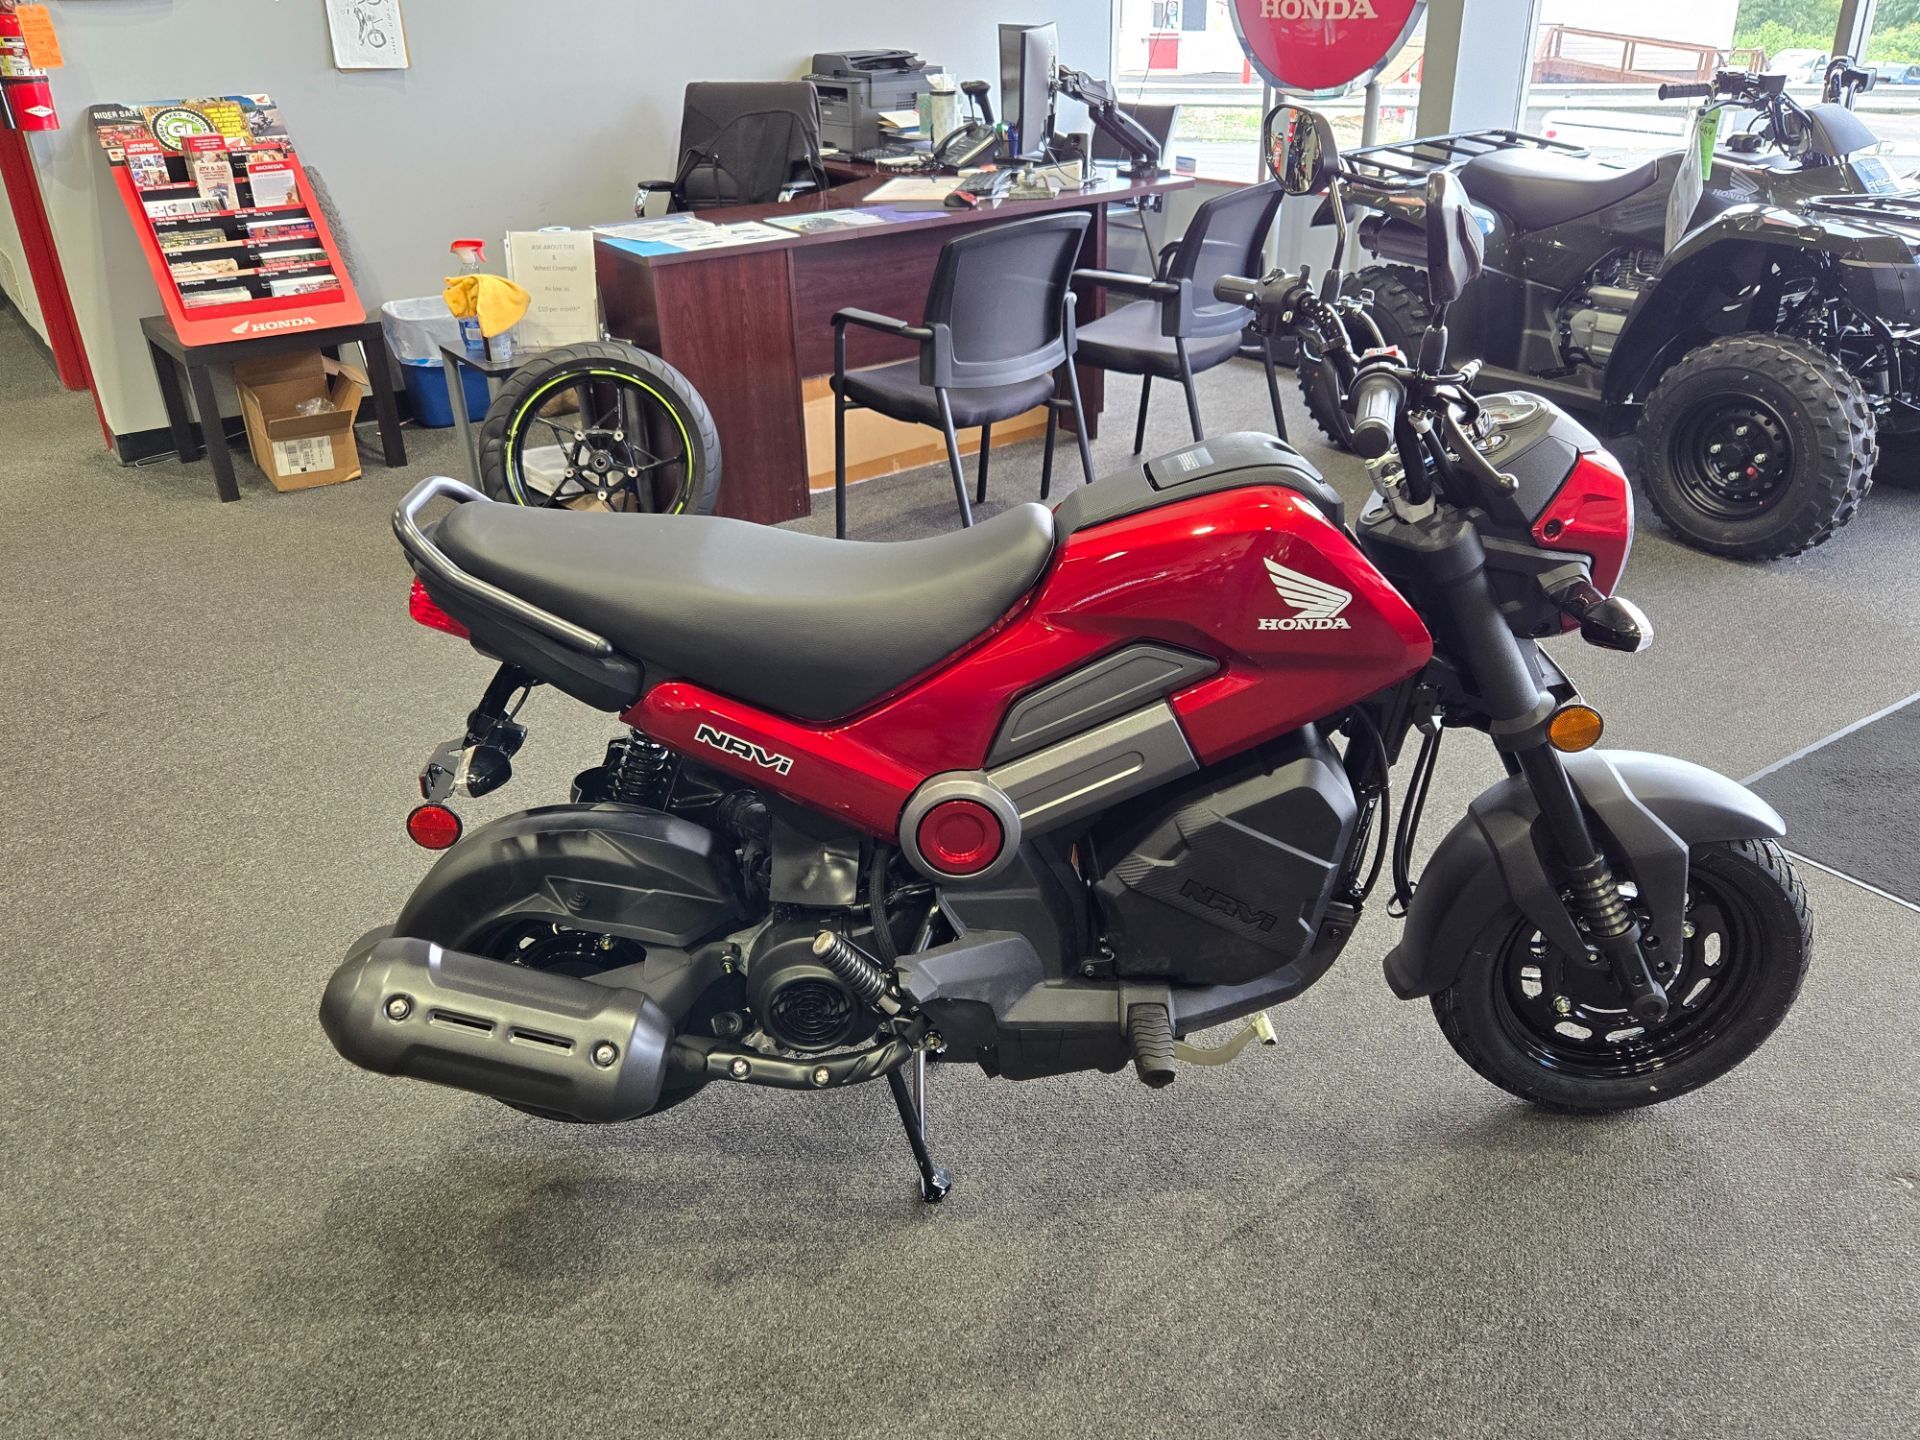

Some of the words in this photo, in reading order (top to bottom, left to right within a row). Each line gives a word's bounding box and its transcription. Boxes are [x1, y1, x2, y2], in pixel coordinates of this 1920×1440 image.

[1260, 0, 1379, 20] HONDA
[94, 111, 118, 120] RIDER
[119, 109, 143, 118] SAFE
[255, 163, 286, 171] HONDA
[1711, 188, 1751, 203] HONDA
[251, 316, 318, 333] HONDA
[1257, 617, 1352, 631] HONDA
